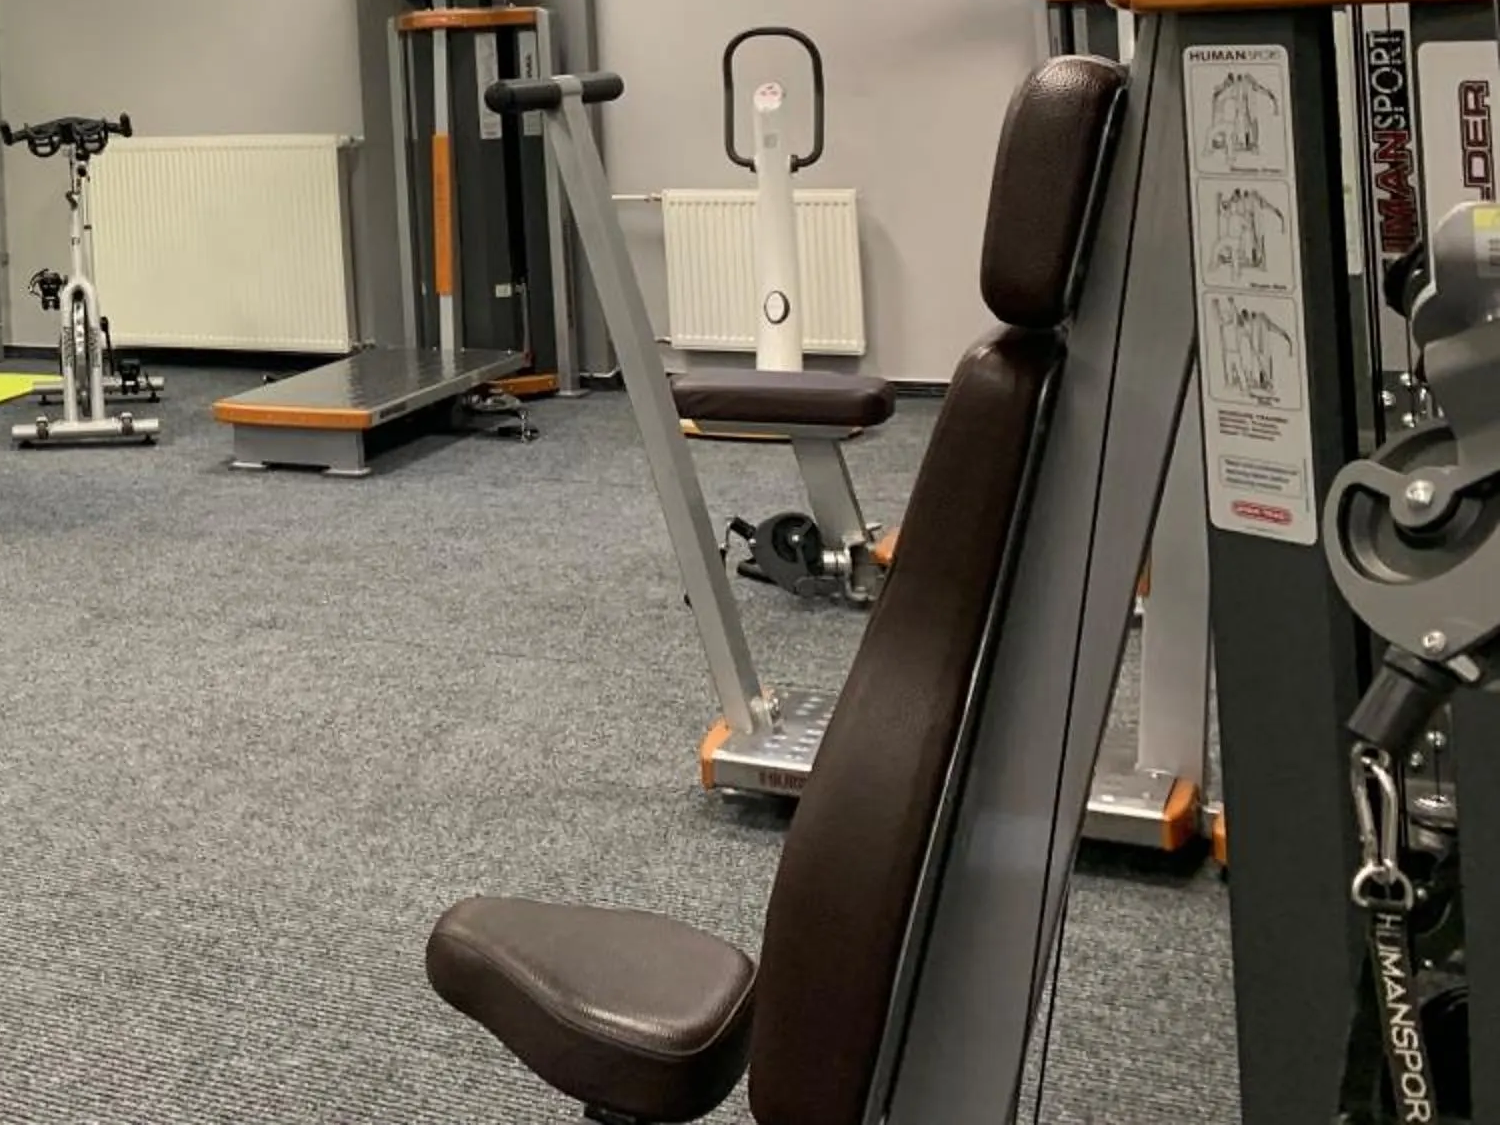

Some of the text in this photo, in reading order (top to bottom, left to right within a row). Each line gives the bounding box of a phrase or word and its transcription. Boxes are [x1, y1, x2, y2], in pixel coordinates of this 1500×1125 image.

[1368, 30, 1421, 253] MANSPORT
[1459, 80, 1496, 201] DER
[1375, 912, 1432, 1124] HUMANSPOR
